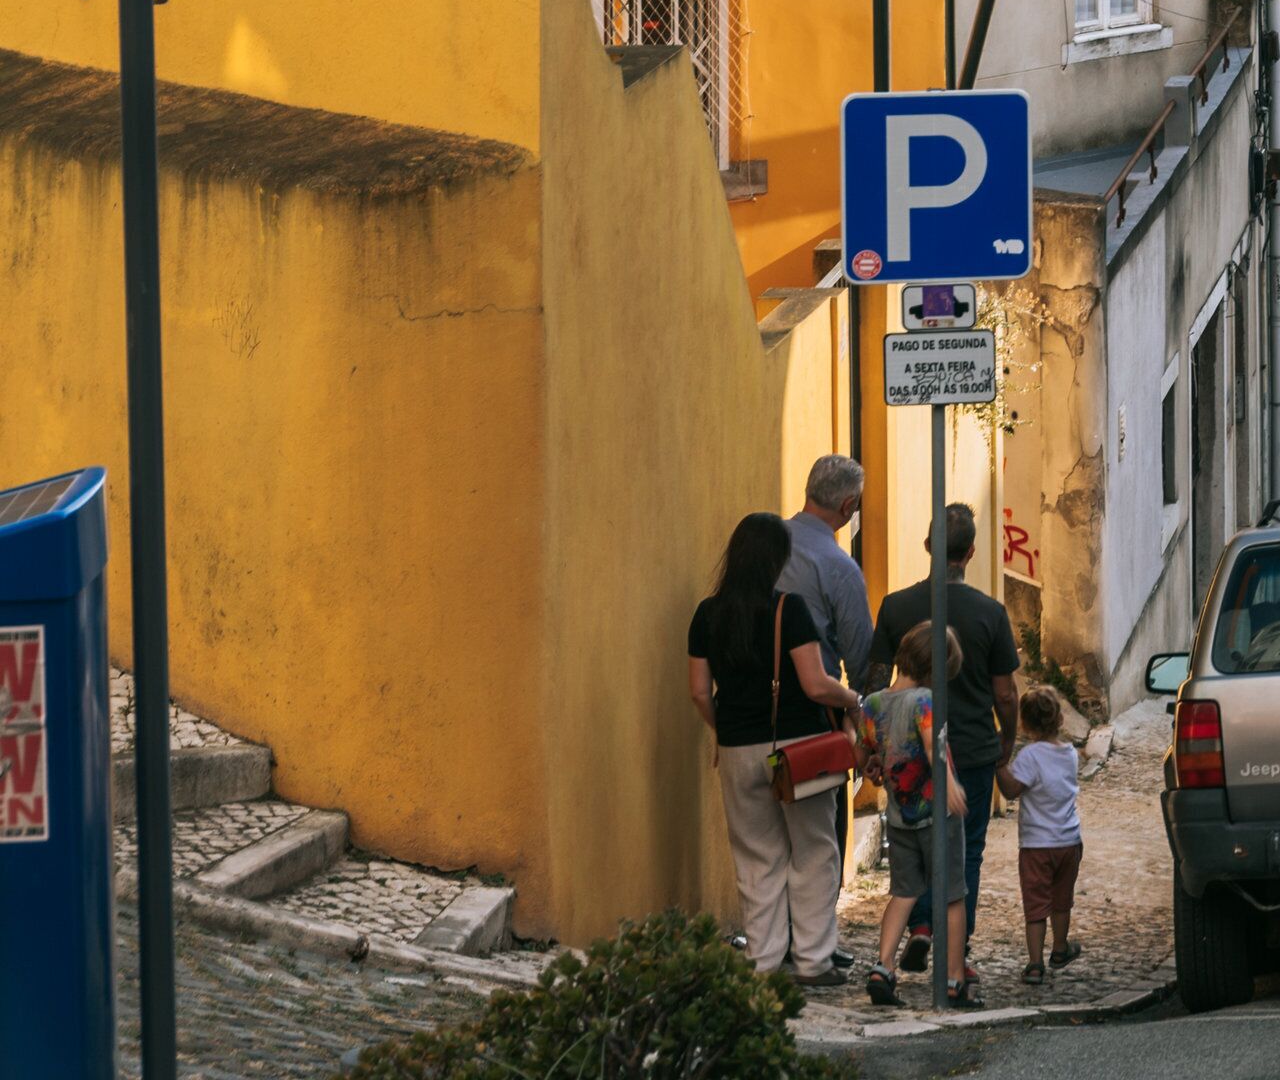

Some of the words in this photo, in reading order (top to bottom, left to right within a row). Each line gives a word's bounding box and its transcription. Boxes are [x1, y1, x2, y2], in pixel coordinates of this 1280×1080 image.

[885, 113, 988, 262] P
[892, 340, 920, 352] PAGO
[922, 339, 935, 350] DE
[938, 338, 988, 350] SEGUNDA
[904, 363, 912, 374] A
[914, 361, 945, 373] SEXTA
[948, 360, 976, 372] FEIRA
[1240, 762, 1280, 778] Jeep
